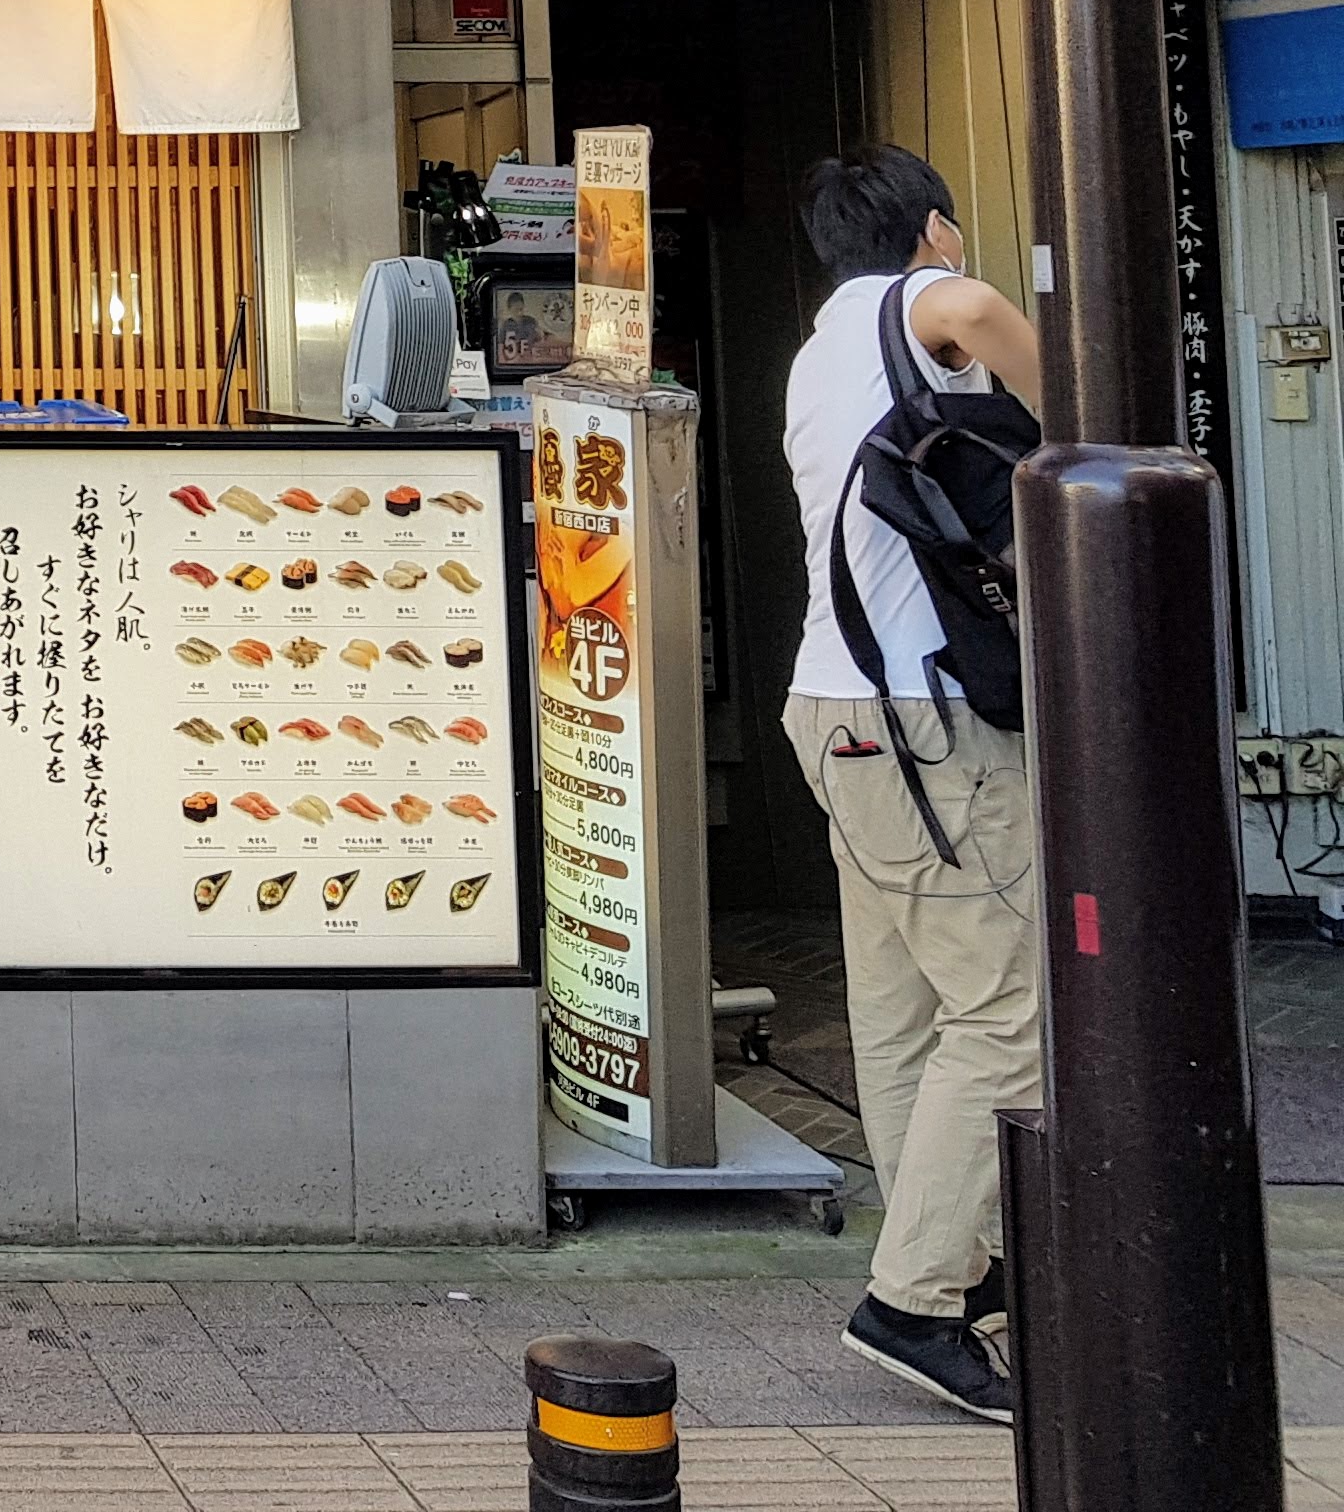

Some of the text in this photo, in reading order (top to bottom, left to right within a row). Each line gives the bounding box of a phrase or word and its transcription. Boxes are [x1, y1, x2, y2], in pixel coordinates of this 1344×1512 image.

[584, 162, 642, 184] 足裏マッサージ
[456, 359, 477, 372] Pay
[555, 510, 611, 534] 新宿西口店
[115, 484, 151, 651] シャリは人肌。
[570, 615, 619, 644] 当ビル
[35, 555, 68, 784] すぐに握りたてを
[569, 639, 624, 696] 4F
[575, 747, 634, 780] 4,800円
[577, 818, 636, 853] 5,800円
[579, 890, 638, 926] 4,980円
[581, 963, 640, 1000] 4,980円
